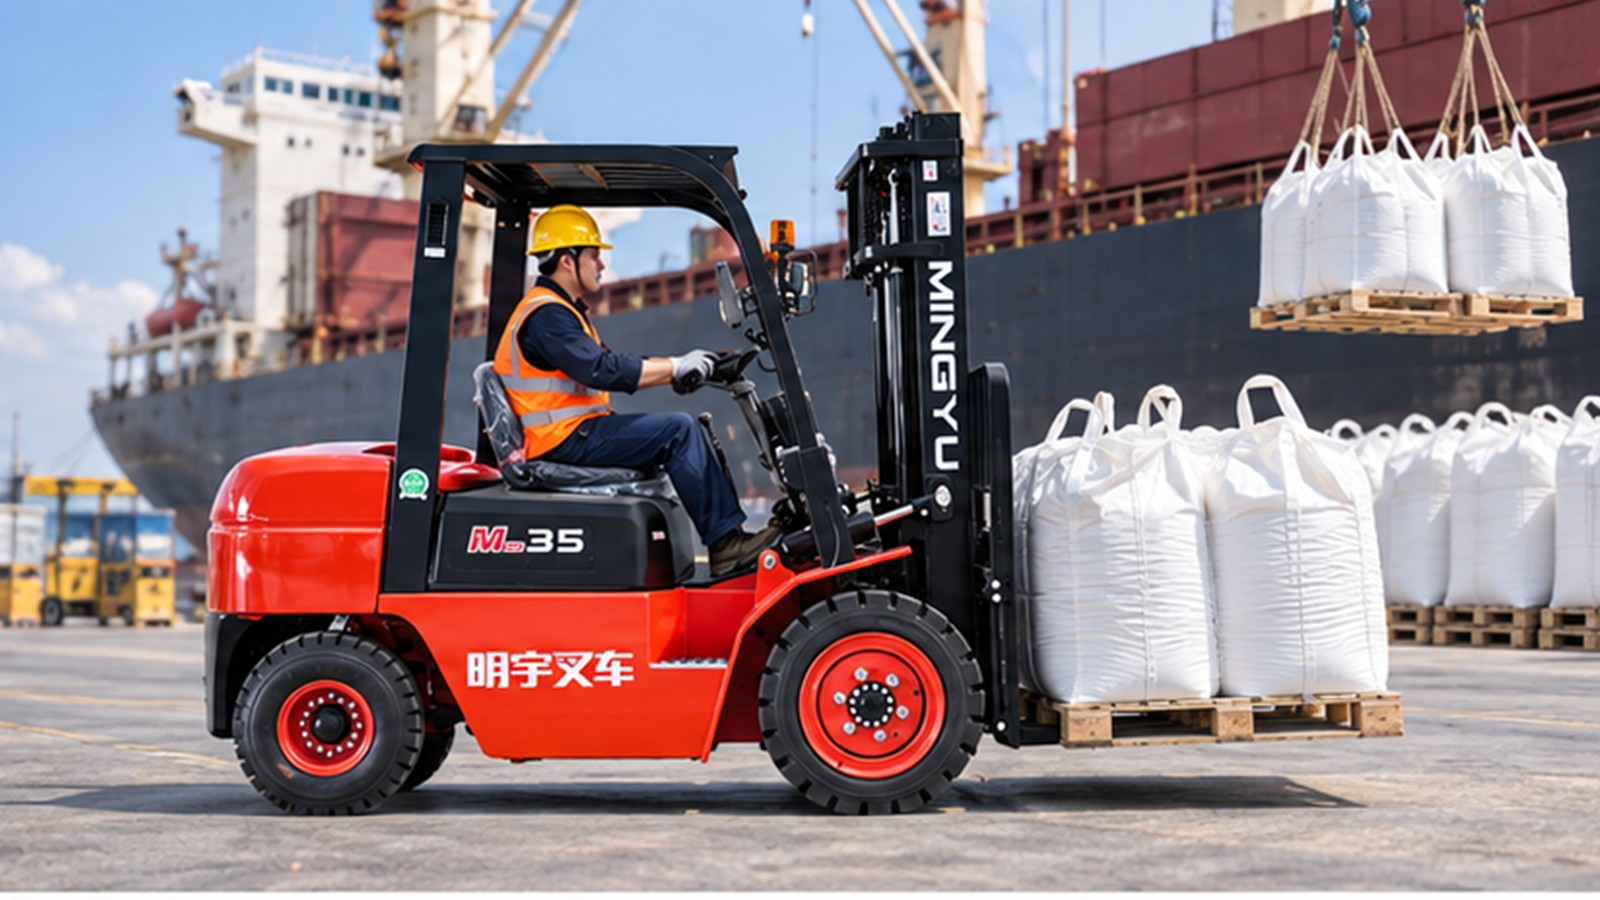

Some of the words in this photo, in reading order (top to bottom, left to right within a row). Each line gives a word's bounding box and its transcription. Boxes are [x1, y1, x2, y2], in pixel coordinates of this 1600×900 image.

[928, 261, 959, 470] MINGYU
[467, 650, 634, 688] 明宇叉车
